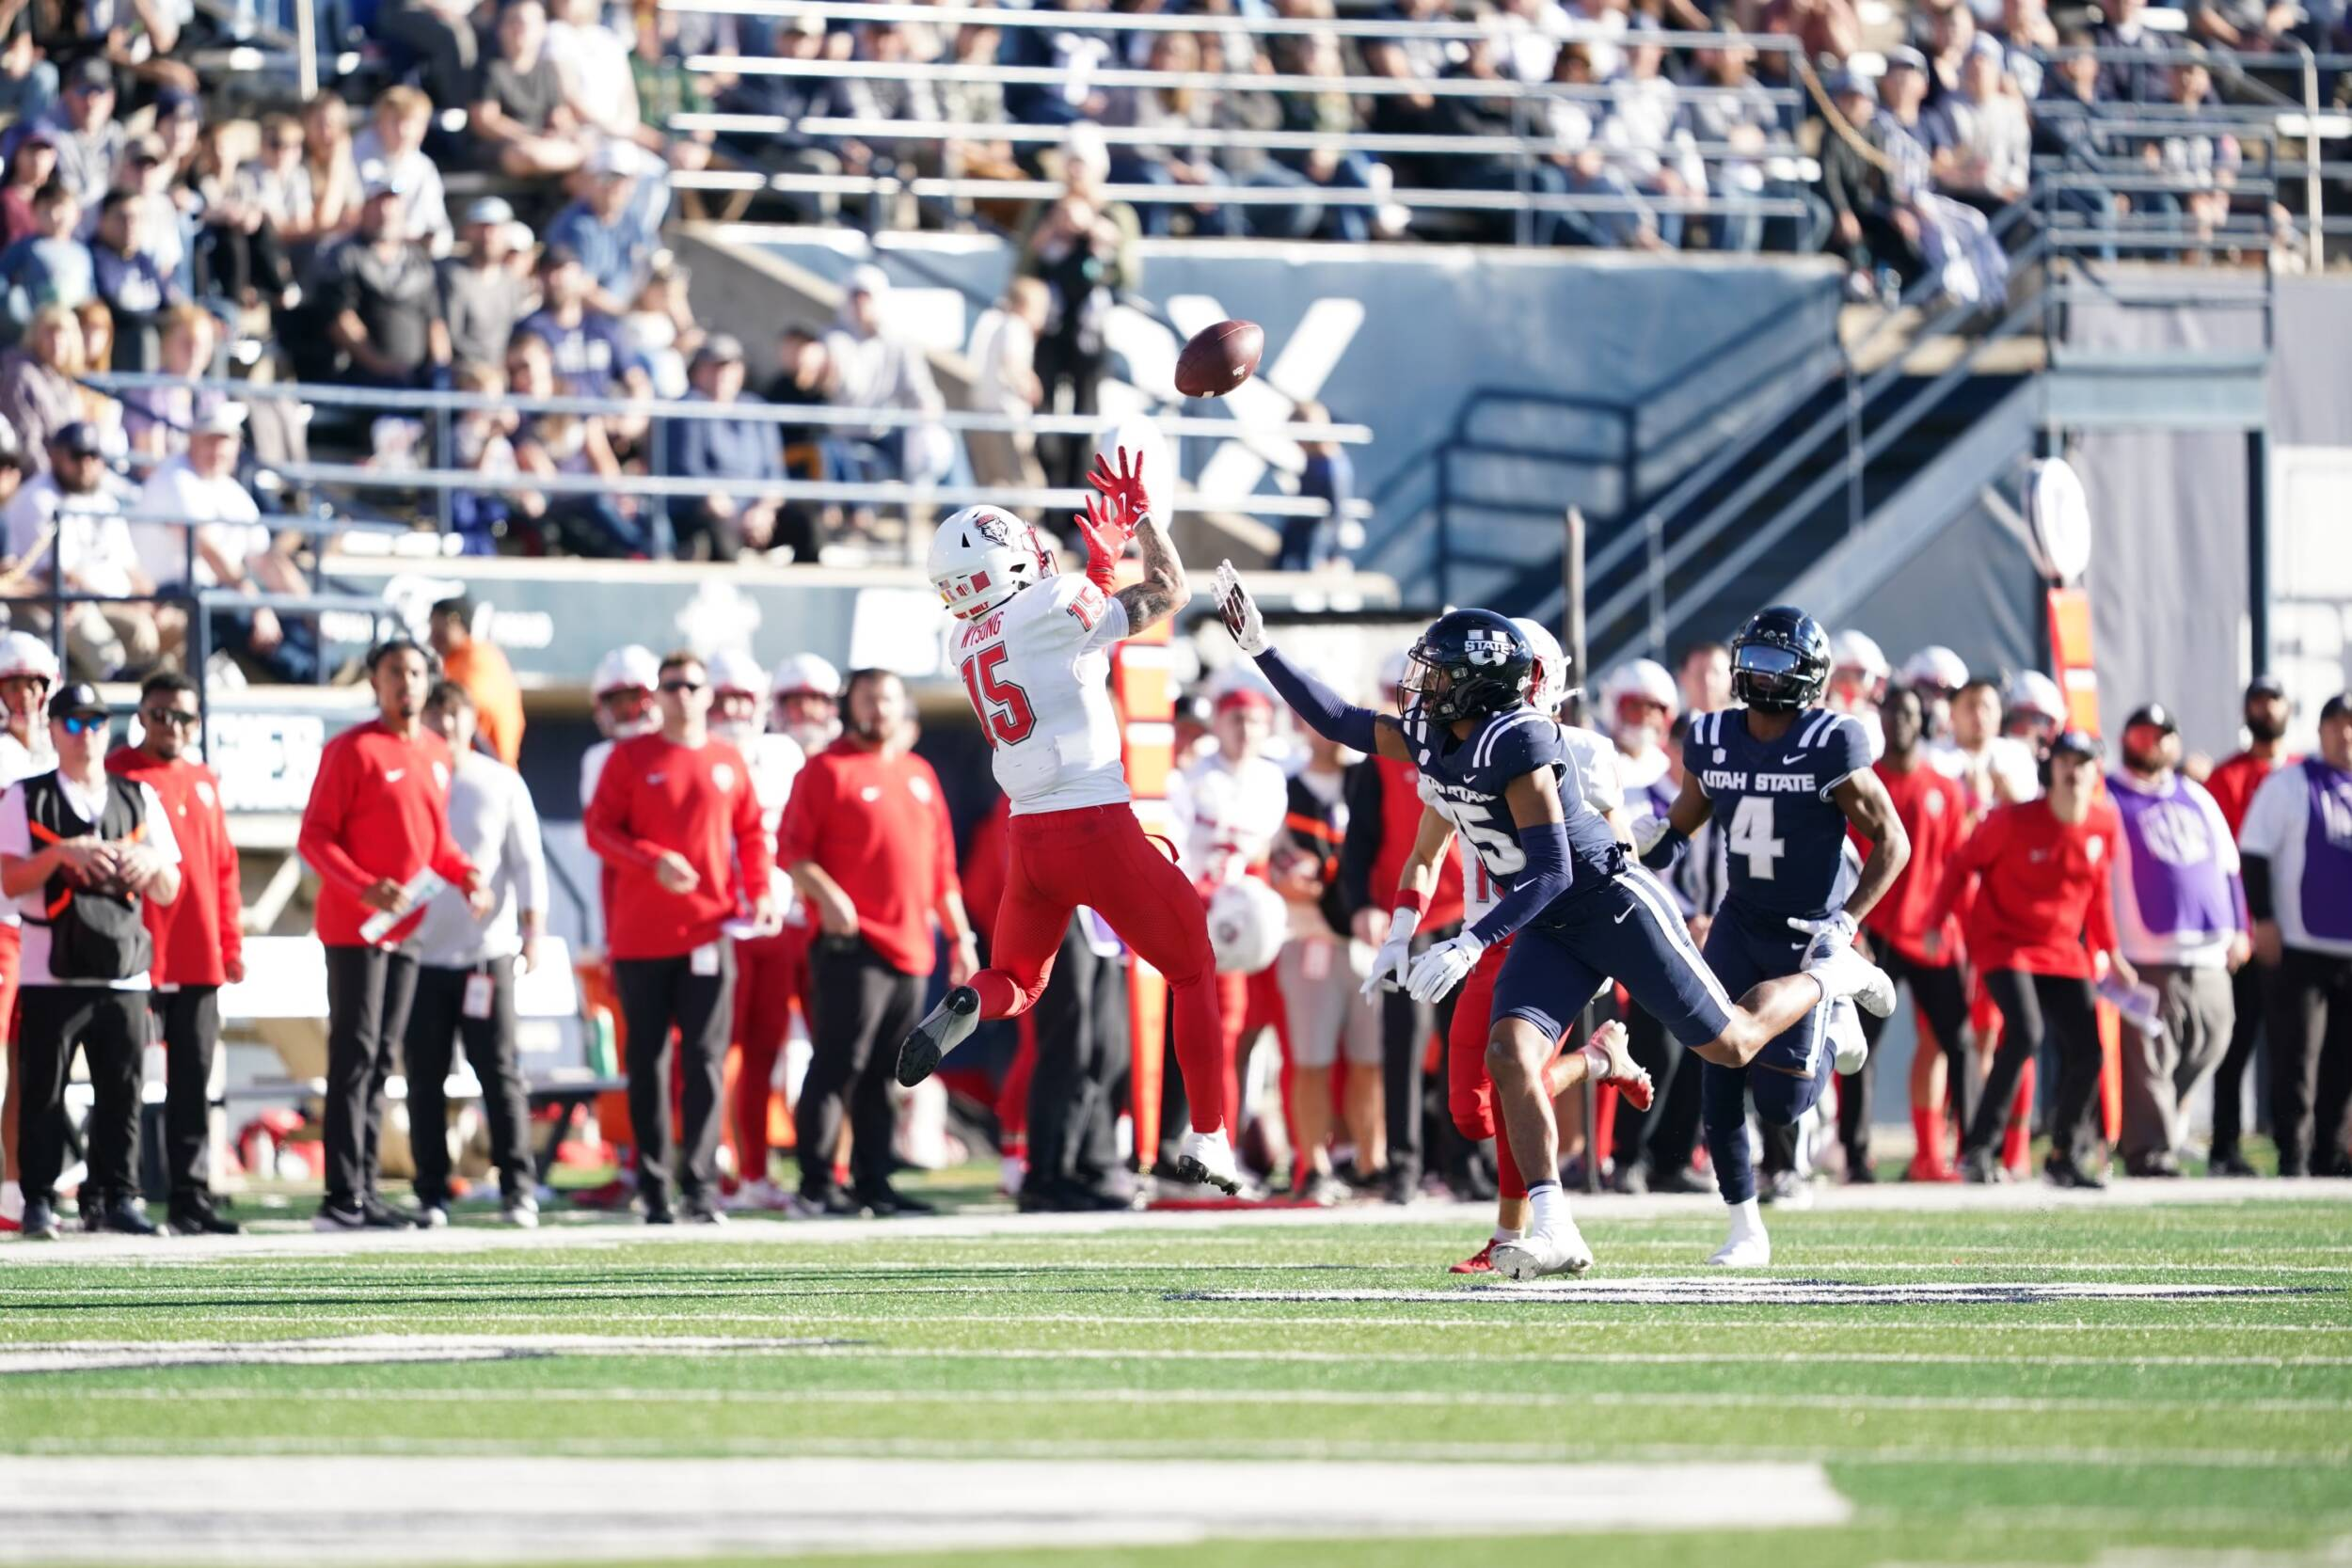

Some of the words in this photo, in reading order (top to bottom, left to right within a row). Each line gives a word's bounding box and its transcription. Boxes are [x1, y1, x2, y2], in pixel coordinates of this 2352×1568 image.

[1066, 586, 1106, 632] 15
[1464, 640, 1511, 657] STATE
[960, 641, 1038, 752] 15
[1702, 769, 1748, 791] UTAH
[1754, 772, 1817, 793] STATE
[1729, 795, 1786, 881] 4
[1475, 850, 1506, 904] 1
